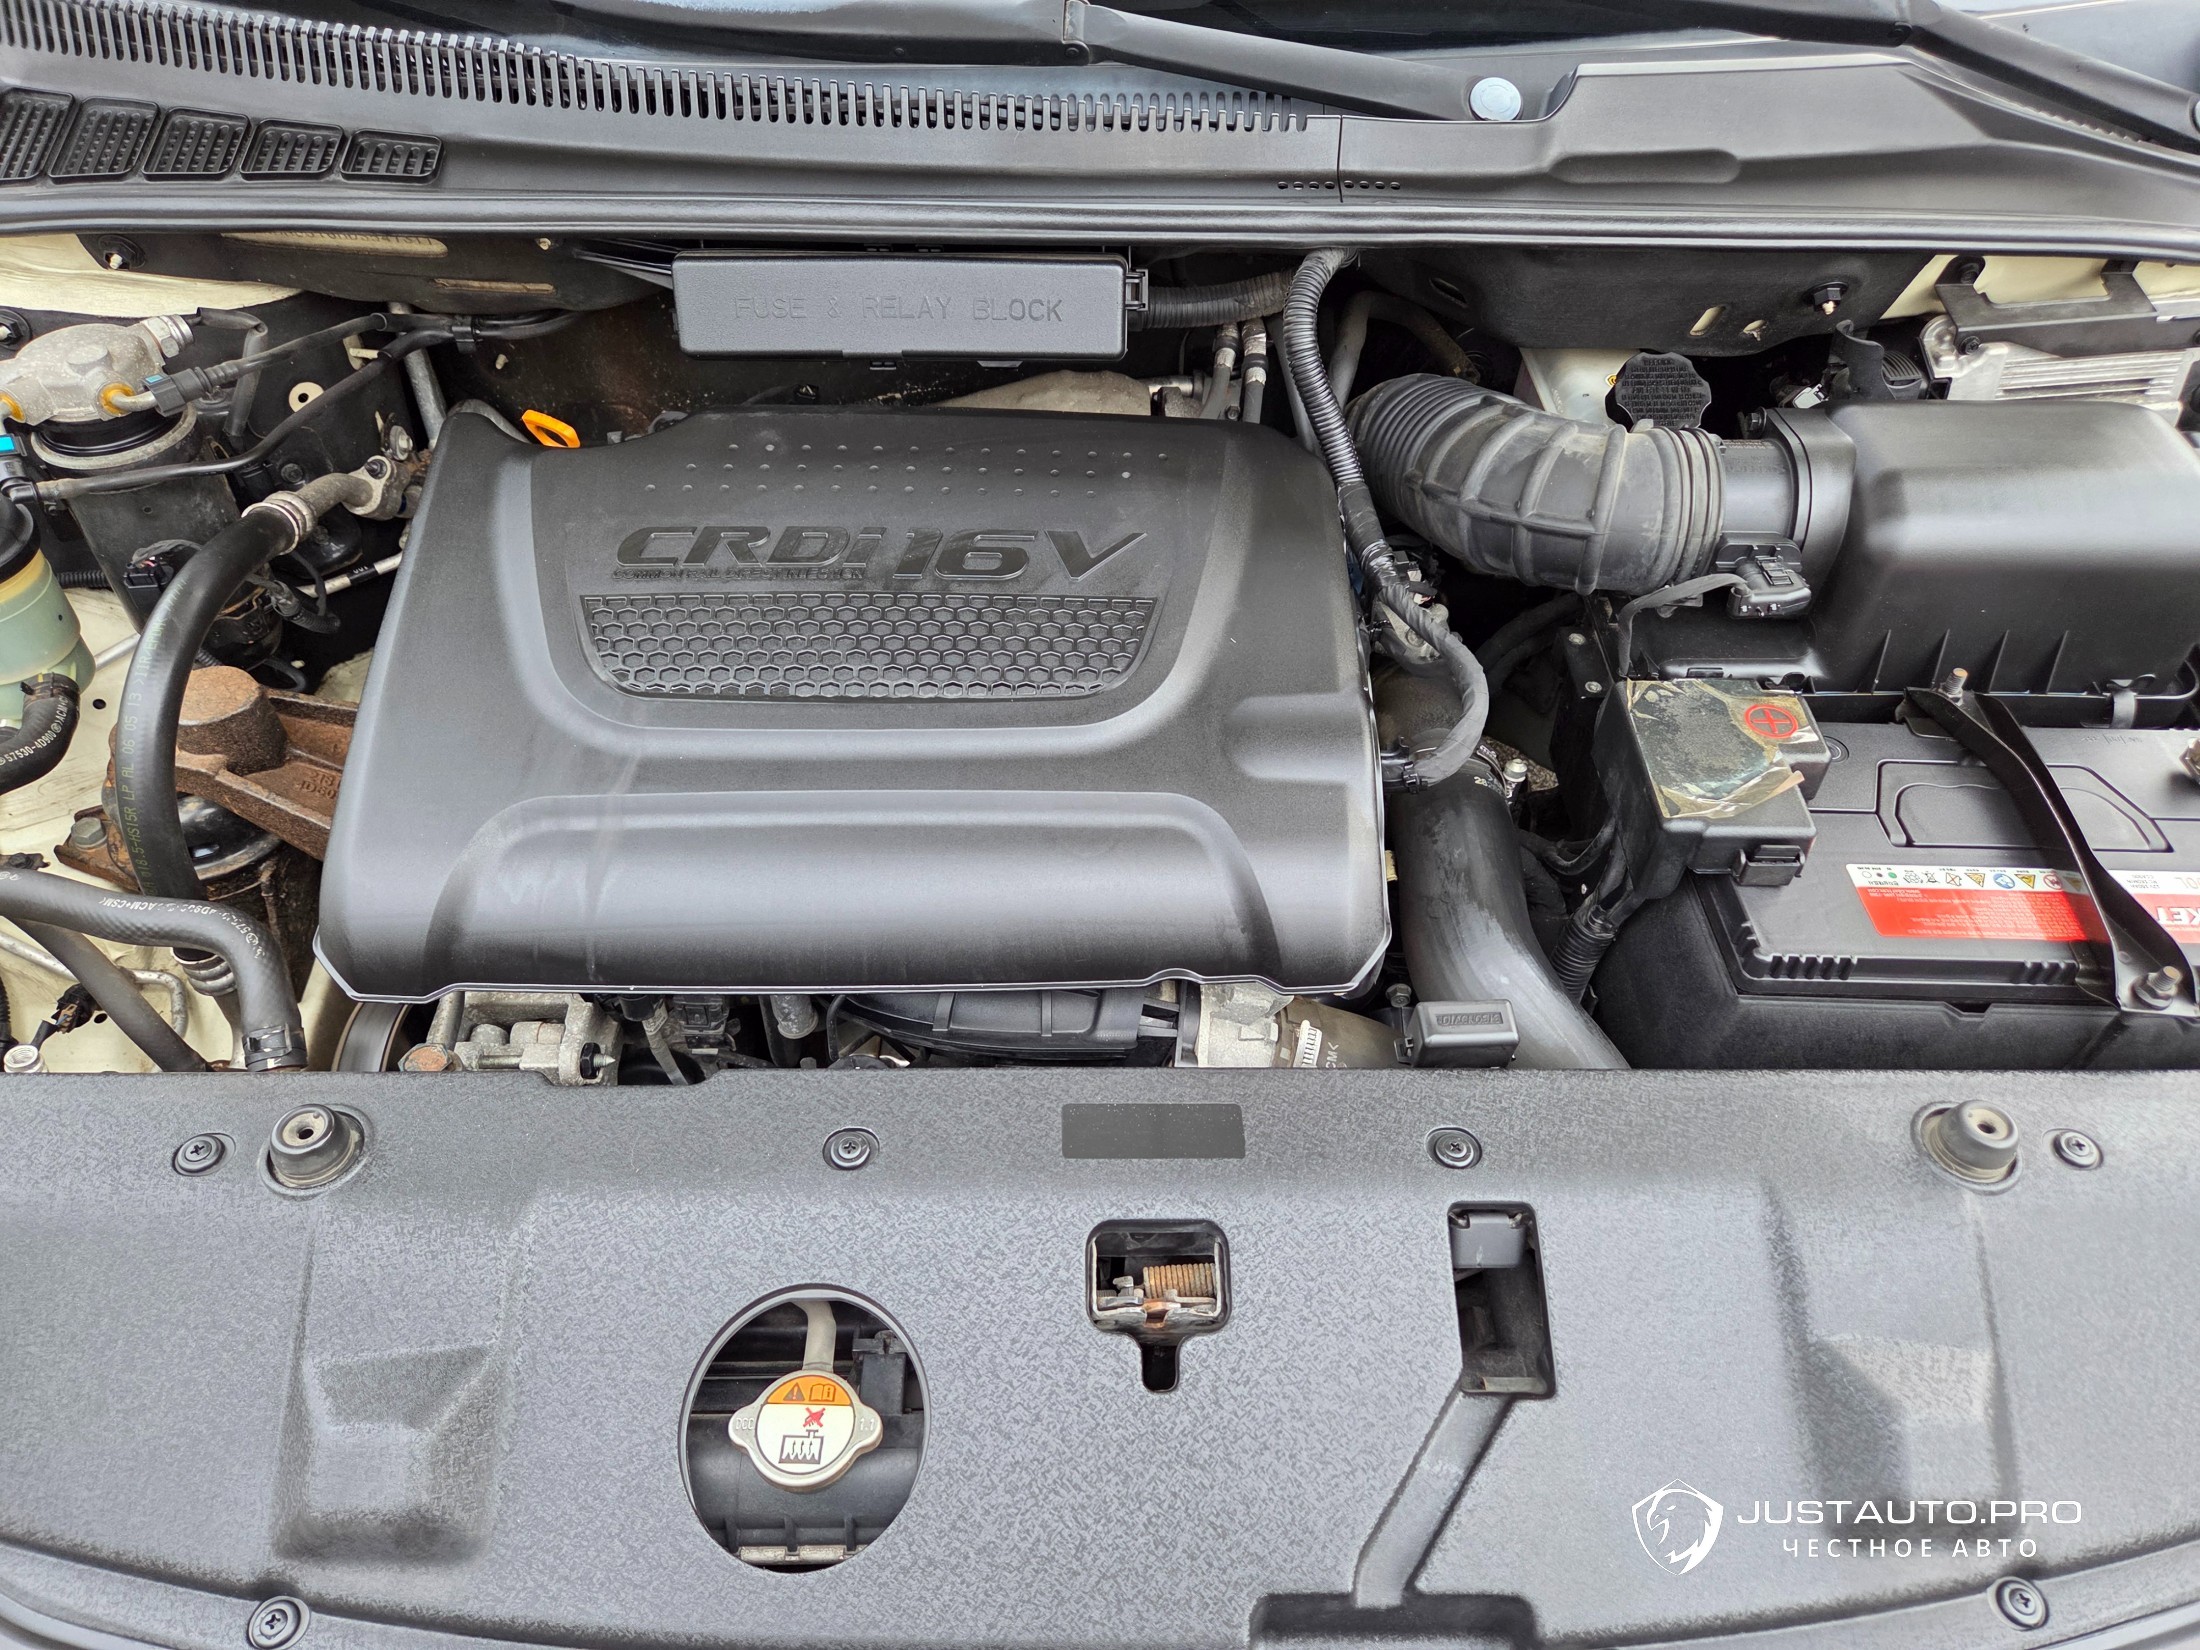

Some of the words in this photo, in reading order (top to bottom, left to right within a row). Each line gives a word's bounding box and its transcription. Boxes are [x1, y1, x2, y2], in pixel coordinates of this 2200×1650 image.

[735, 298, 807, 319] FUSE
[826, 296, 842, 318] &
[862, 296, 951, 320] RELAY
[972, 298, 1063, 322] BLOCK
[616, 526, 888, 568] CRDi
[892, 527, 1148, 582] 16V
[613, 569, 683, 581] COMMON
[726, 569, 784, 580] DIRECT
[786, 569, 864, 580] INJECTION
[125, 715, 138, 731] 05
[122, 739, 136, 755] 06
[121, 784, 136, 802] LP
[1441, 1012, 1501, 1026] DIAGNOSIS
[859, 1417, 876, 1431] 1.1
